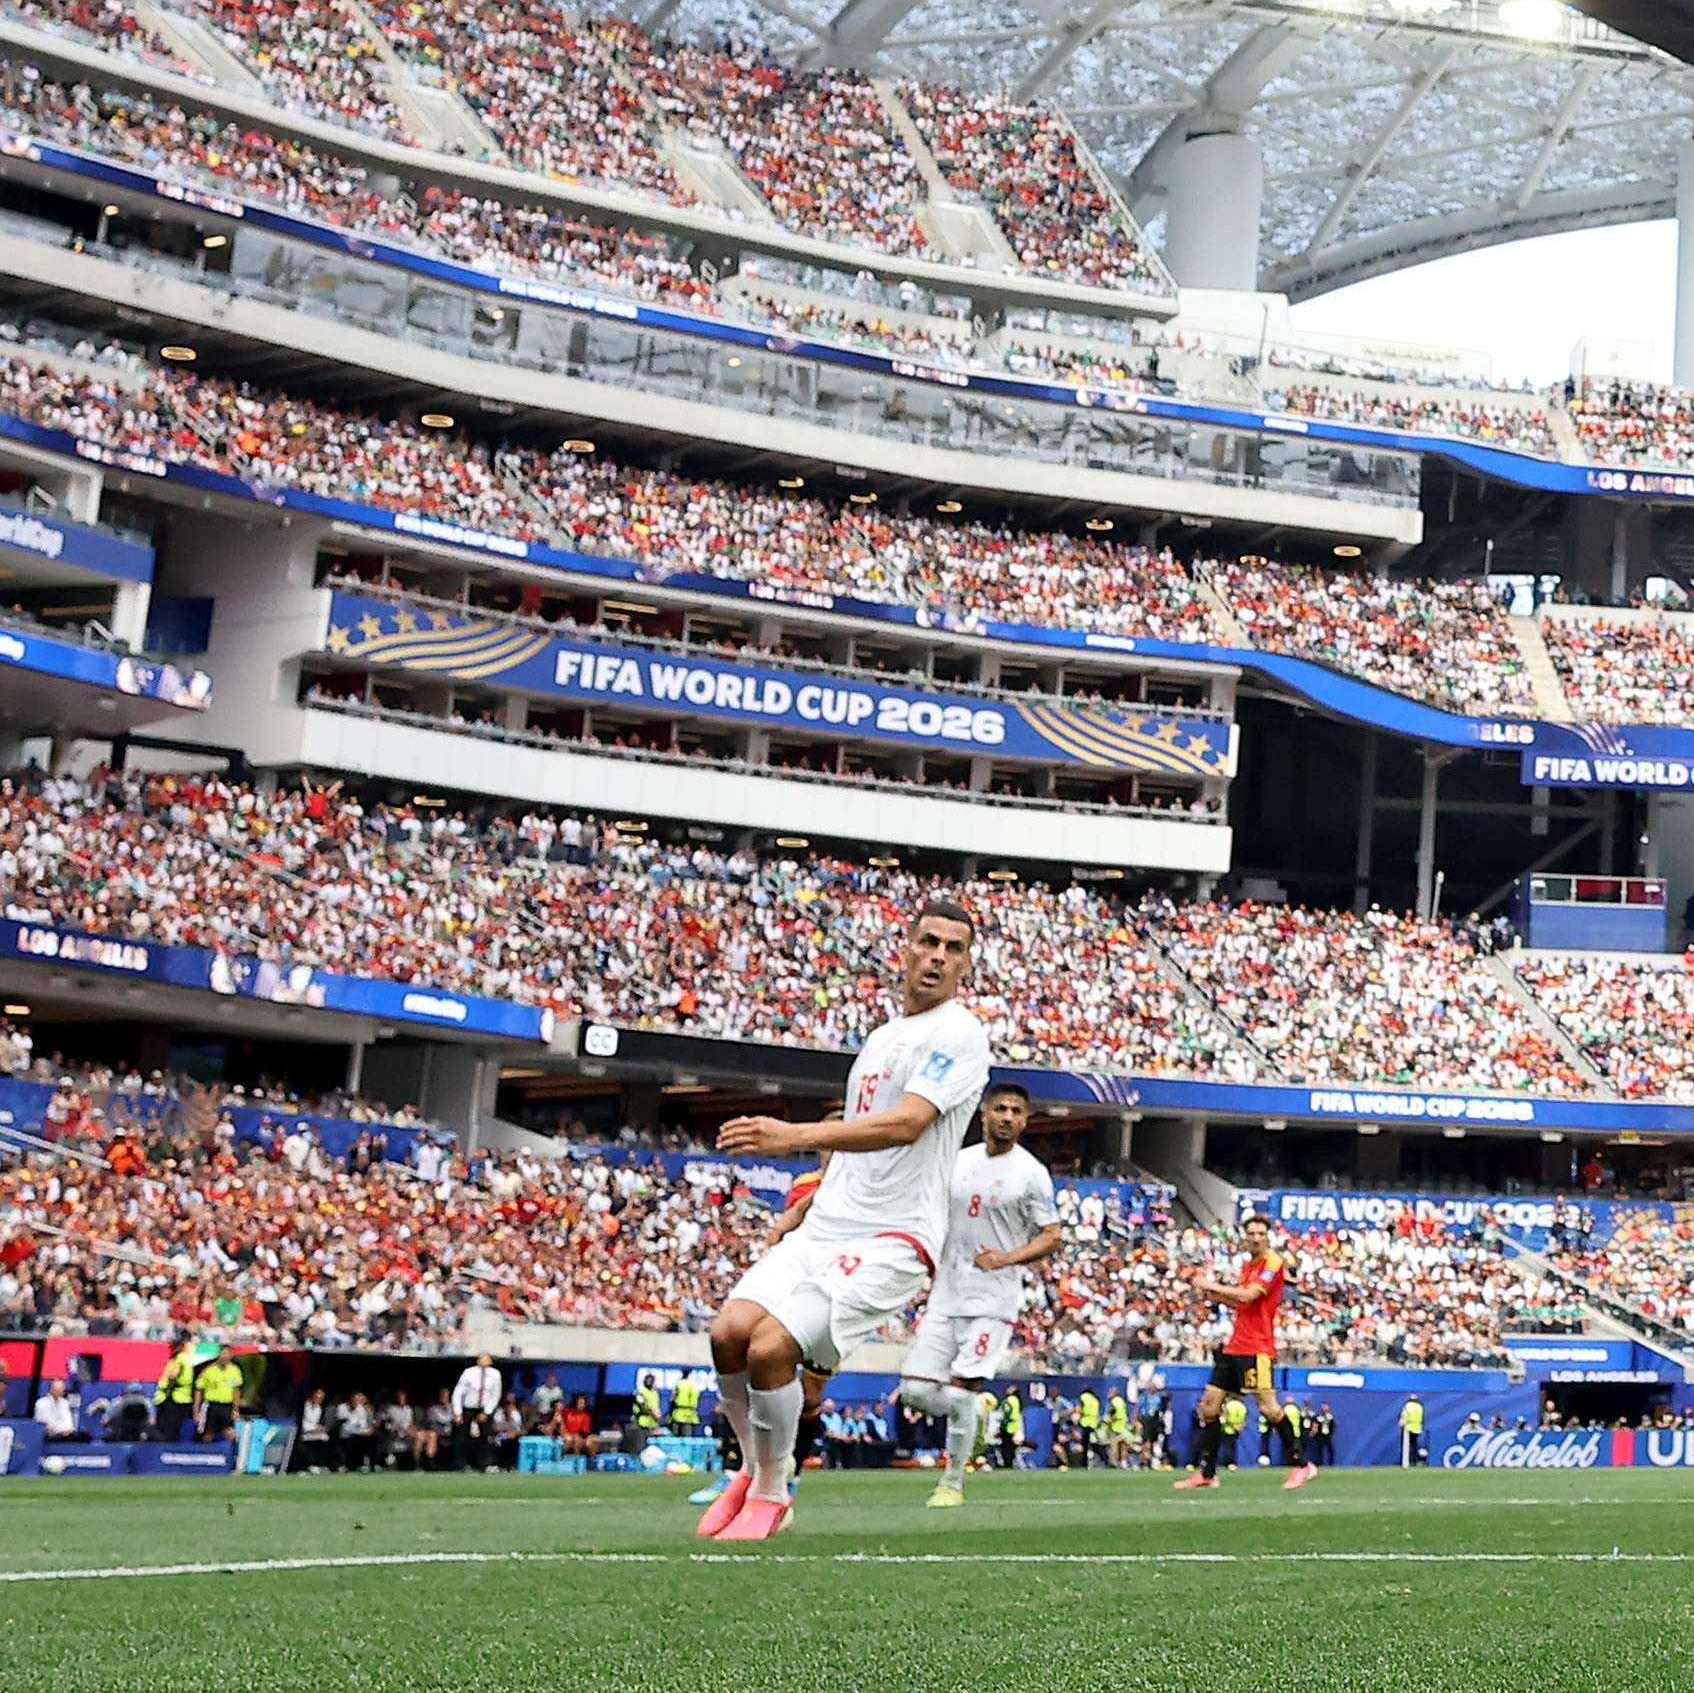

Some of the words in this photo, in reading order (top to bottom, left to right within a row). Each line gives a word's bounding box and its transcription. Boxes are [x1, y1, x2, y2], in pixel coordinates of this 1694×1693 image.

[1587, 471, 1627, 492] LOS
[555, 650, 645, 699] FIFA
[649, 663, 793, 716] WORLD
[796, 684, 874, 726] CUP
[876, 696, 1006, 744] 2026
[1534, 757, 1591, 782] FIFA
[1594, 760, 1688, 786] WORLD
[1310, 1093, 1354, 1113] FIFA
[1355, 1094, 1425, 1116] WORLD
[1426, 1097, 1466, 1117] CUP
[969, 1194, 982, 1217] 8
[1281, 1195, 1340, 1221] FIFA
[975, 1333, 990, 1357] 8
[1443, 1425, 1600, 1468] Michelob
